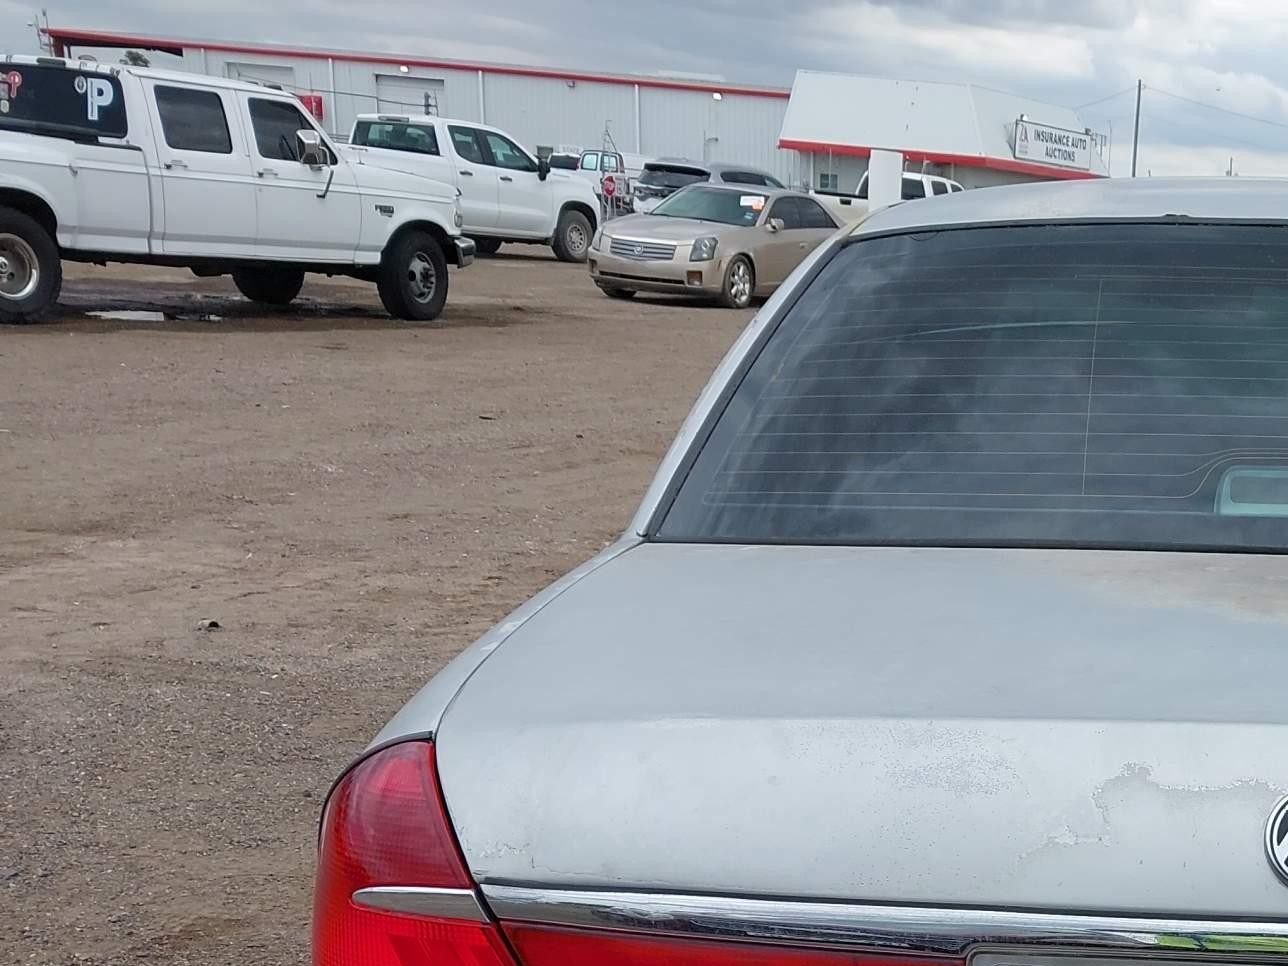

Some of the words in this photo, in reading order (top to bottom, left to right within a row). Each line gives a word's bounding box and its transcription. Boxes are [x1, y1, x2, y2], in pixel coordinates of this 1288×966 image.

[1033, 128, 1071, 147] INSURANCE
[1071, 138, 1087, 150] AUTO
[1045, 146, 1076, 162] AUCTIONS
